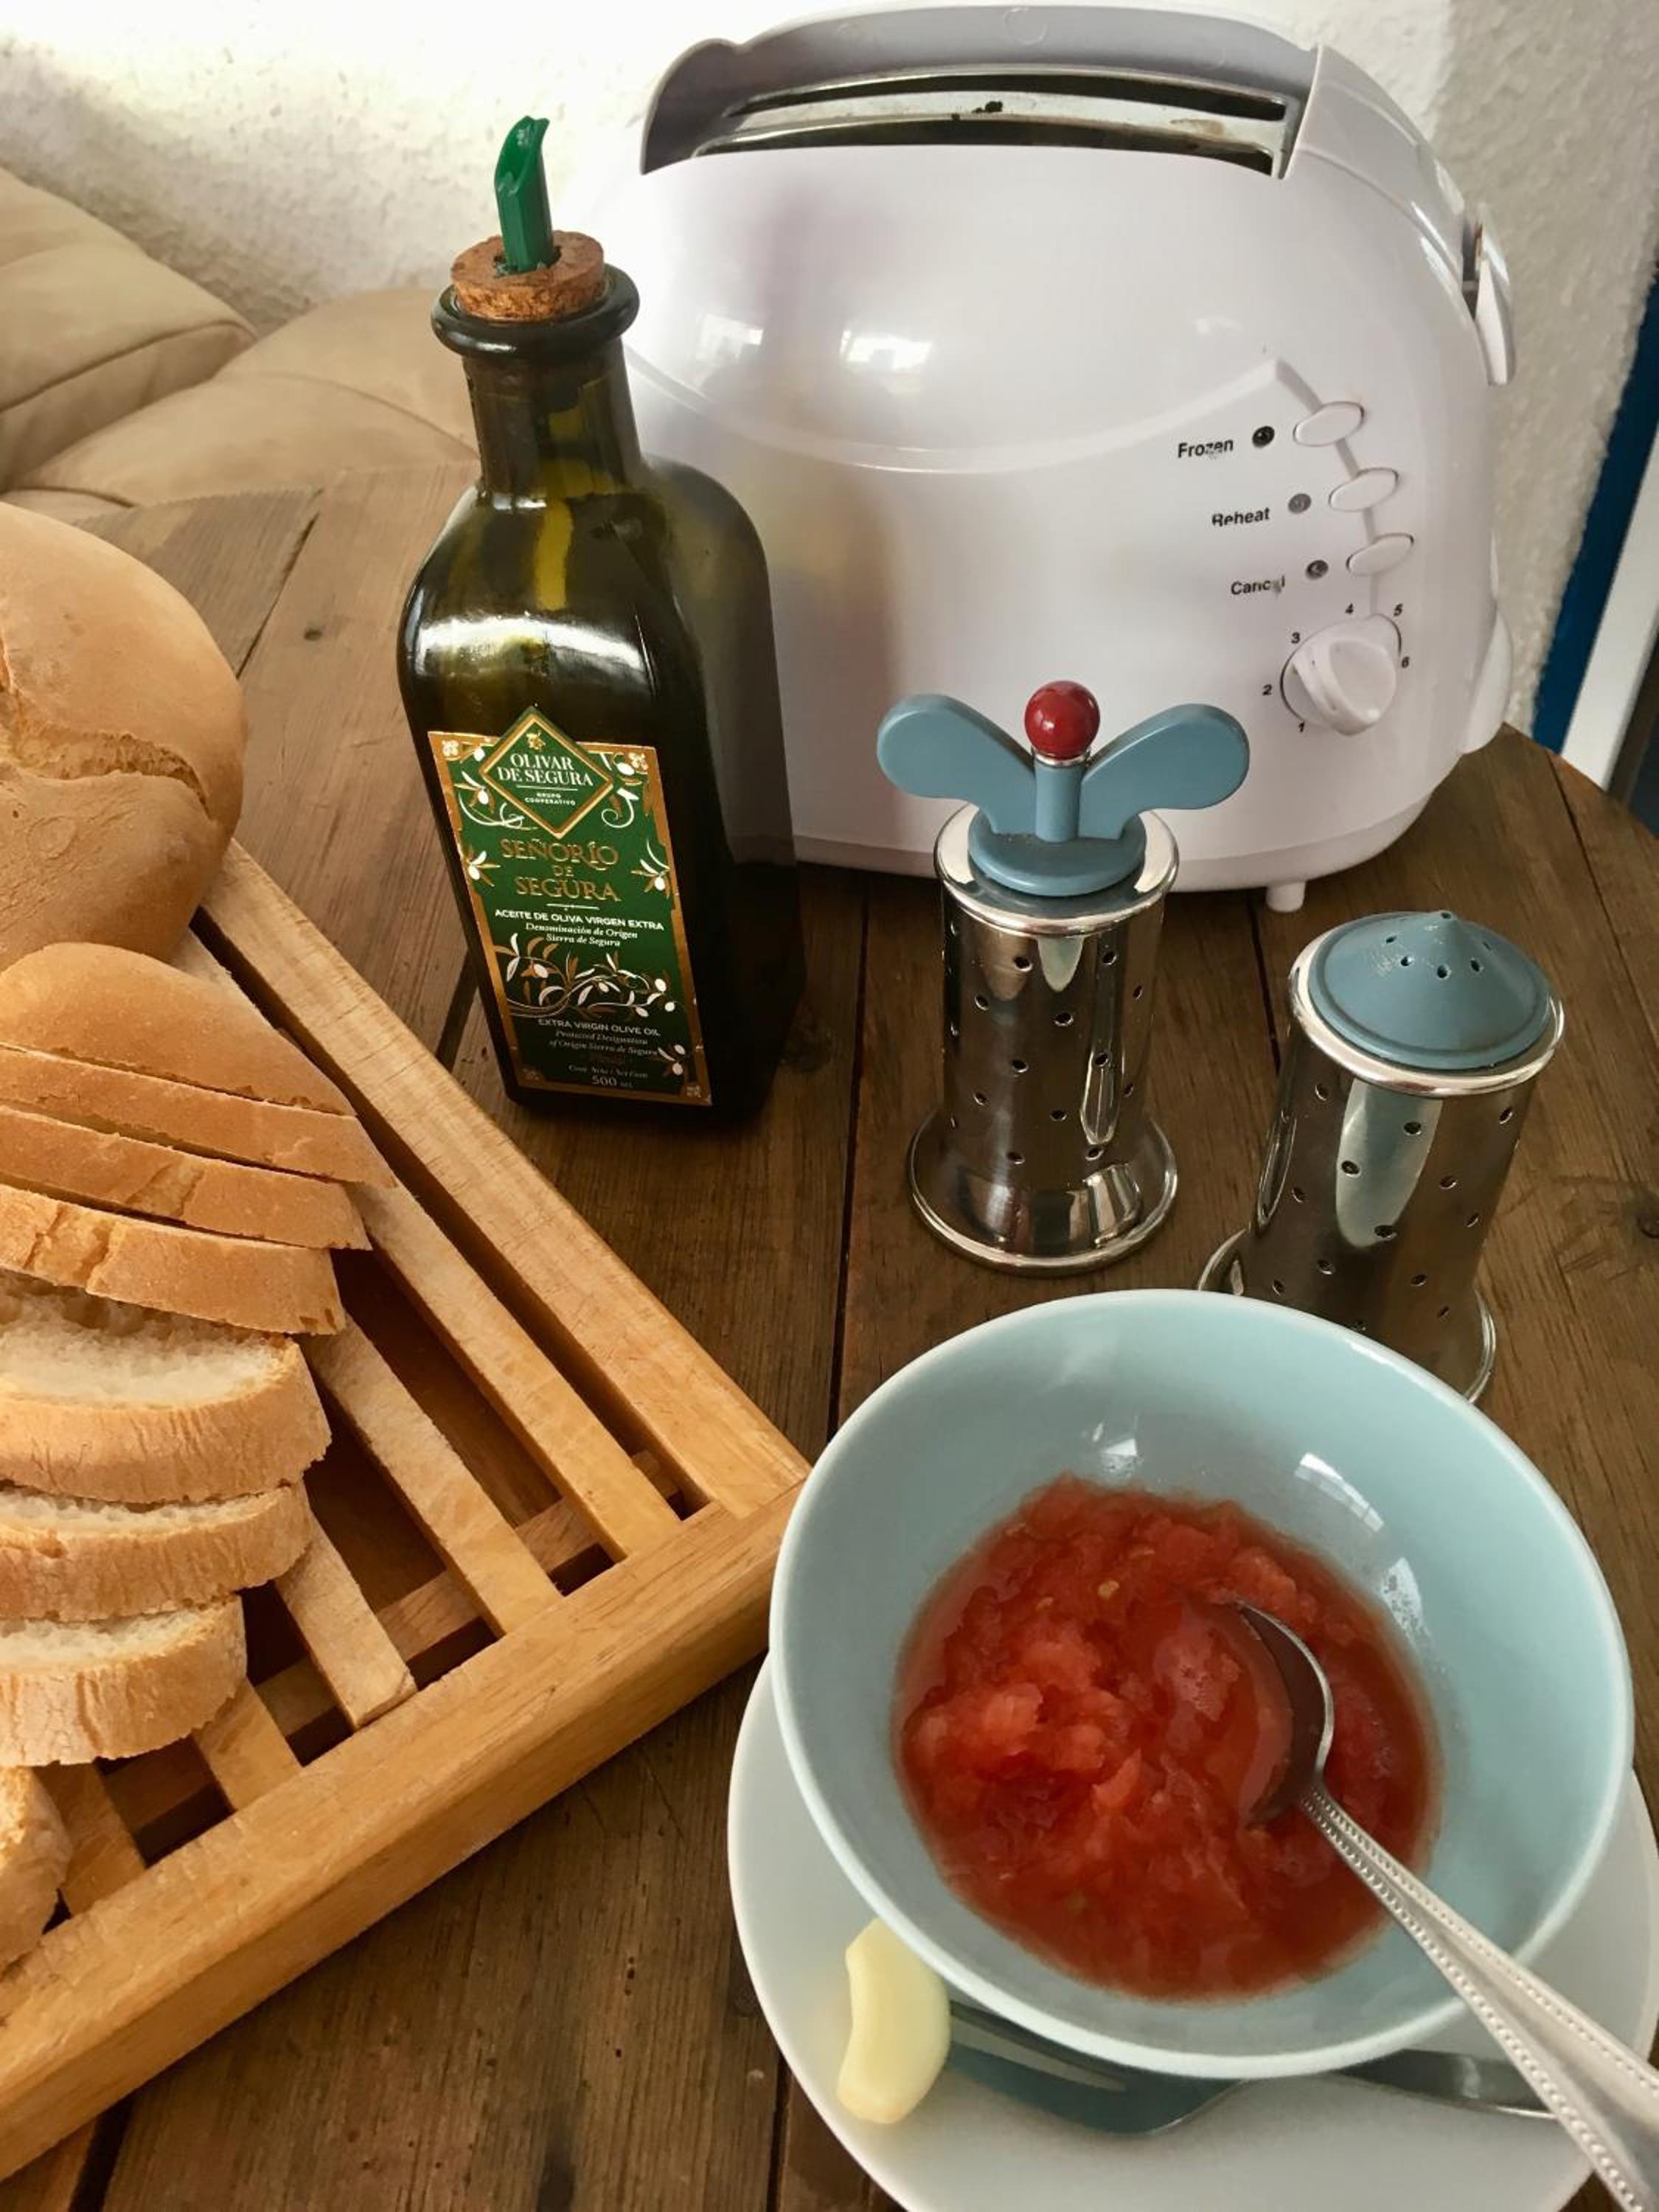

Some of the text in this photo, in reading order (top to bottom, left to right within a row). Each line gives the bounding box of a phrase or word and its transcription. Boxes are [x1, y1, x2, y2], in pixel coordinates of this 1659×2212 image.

[1178, 439, 1234, 458] Frozen
[1211, 507, 1270, 527] Reheat
[1231, 577, 1285, 596] Cancl
[1346, 604, 1354, 615] 4
[1394, 605, 1403, 616] 5
[1291, 633, 1301, 644] 3
[1402, 656, 1410, 668] 6
[1262, 685, 1272, 696] 2
[1298, 722, 1304, 732] 1
[510, 753, 574, 771] OLIVAR
[498, 767, 594, 787] DE SEGURA
[524, 797, 576, 806] COOPERATIVO
[554, 865, 574, 877] DE
[515, 876, 621, 902] SEGURA
[495, 909, 664, 931] ACEITE DE OLIVA VIRGEN EXTRA
[593, 927, 604, 936] de
[606, 928, 638, 939] Origen
[546, 933, 620, 947] Sierra de Segura
[538, 1018, 572, 1029] EXTRA
[574, 1021, 609, 1032] VIRGIN
[611, 1024, 641, 1035] OLIVE
[592, 1076, 617, 1086] 500
